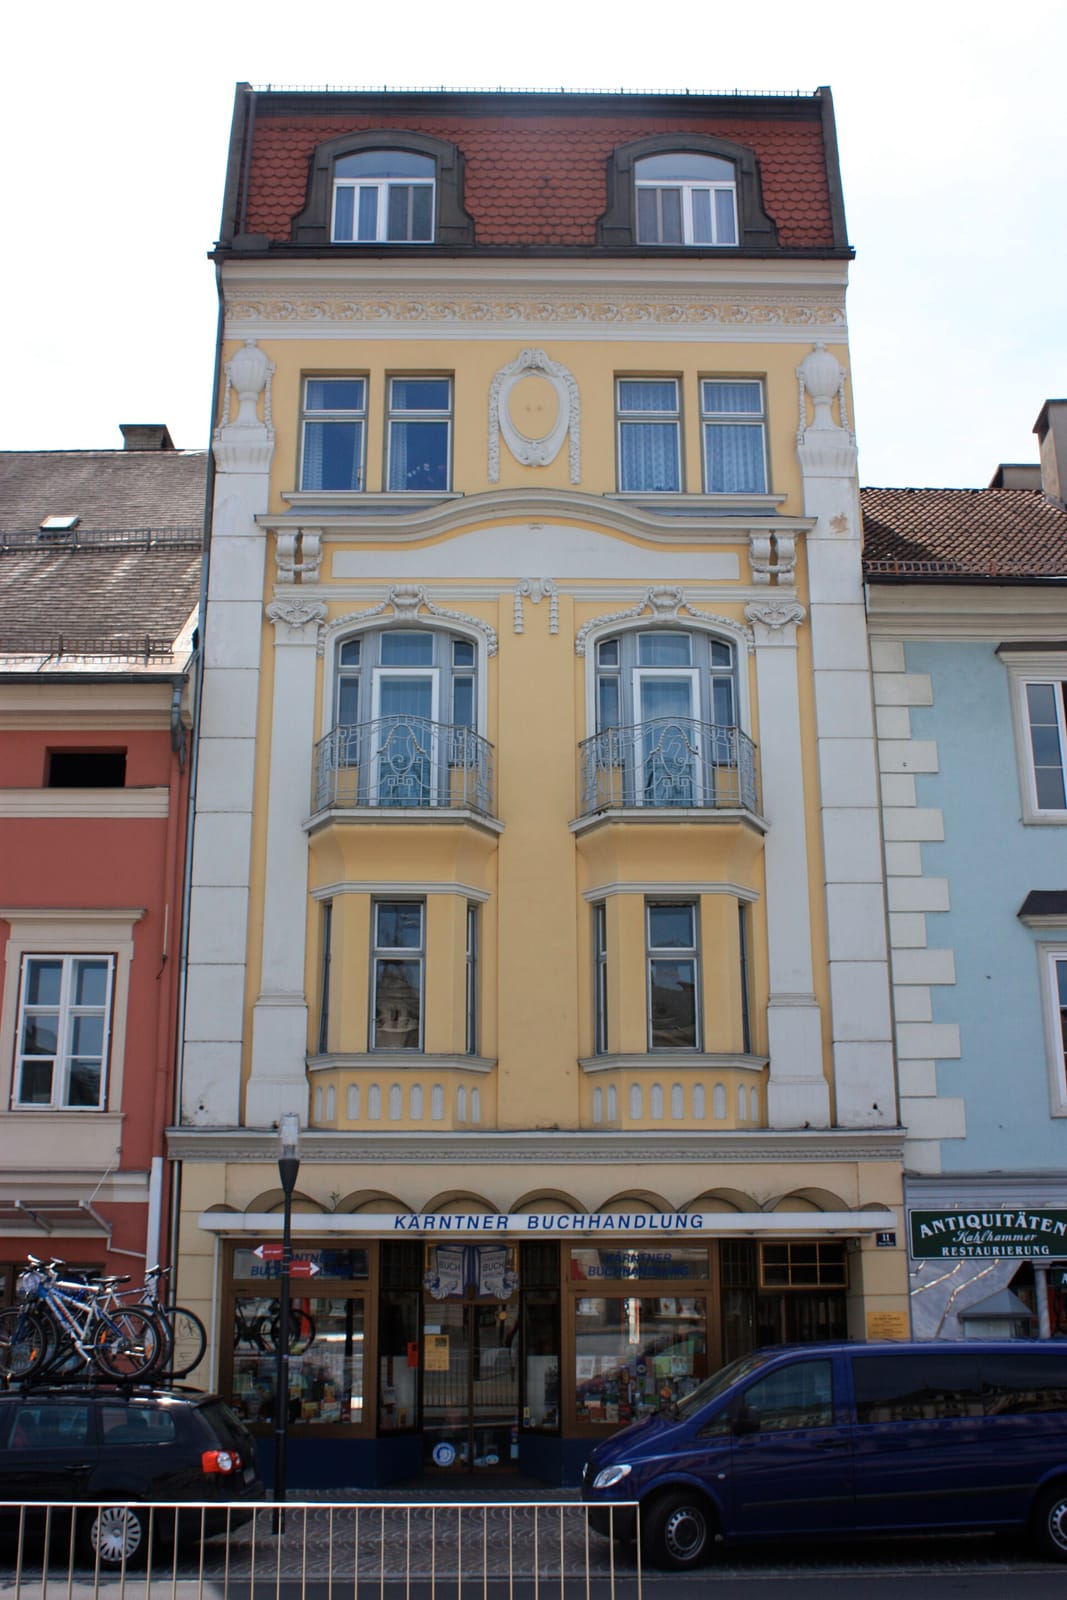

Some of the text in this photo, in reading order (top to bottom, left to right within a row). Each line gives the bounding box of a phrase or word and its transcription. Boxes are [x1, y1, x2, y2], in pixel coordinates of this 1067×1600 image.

[394, 1214, 703, 1229] KÄRNTNER BUCHHANDLUNG
[920, 1212, 1067, 1238] ANTIQUITÄTEN
[882, 1233, 890, 1241] 11
[942, 1245, 1049, 1256] RESTAURIERUNG
